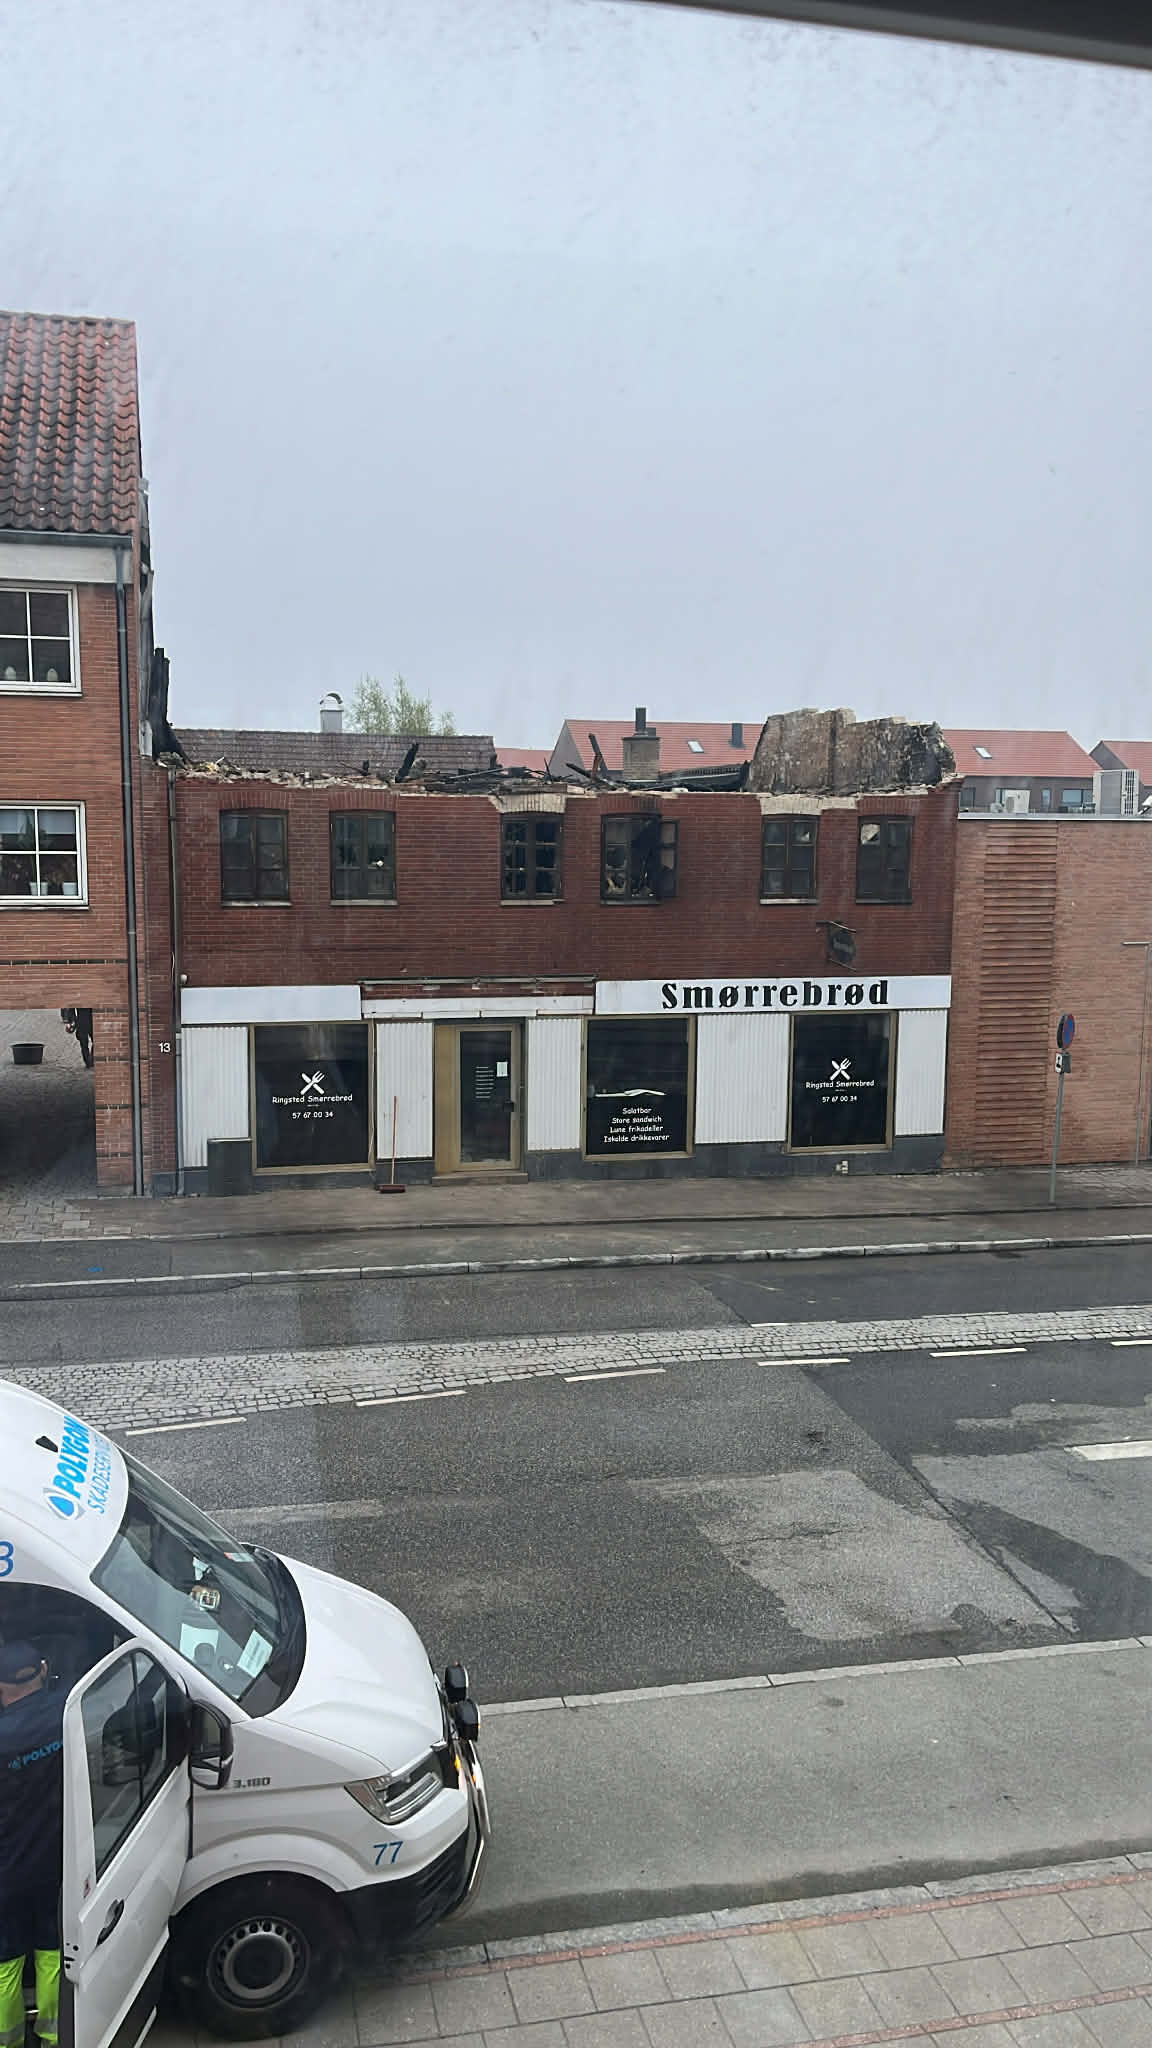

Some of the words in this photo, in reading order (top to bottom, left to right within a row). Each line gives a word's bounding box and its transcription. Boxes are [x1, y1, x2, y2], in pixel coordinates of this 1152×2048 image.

[661, 979, 889, 1009] Smørrebrød
[158, 1042, 171, 1053] 13
[805, 1081, 834, 1090] Ringsted
[272, 1096, 305, 1105] Ringsted
[303, 1111, 312, 1119] 67
[632, 1115, 662, 1124] sandwich
[609, 1126, 626, 1134] Lune
[53, 1415, 90, 1499] POLYGON
[23, 1740, 63, 1766] POLYG
[373, 1841, 403, 1866] 77
